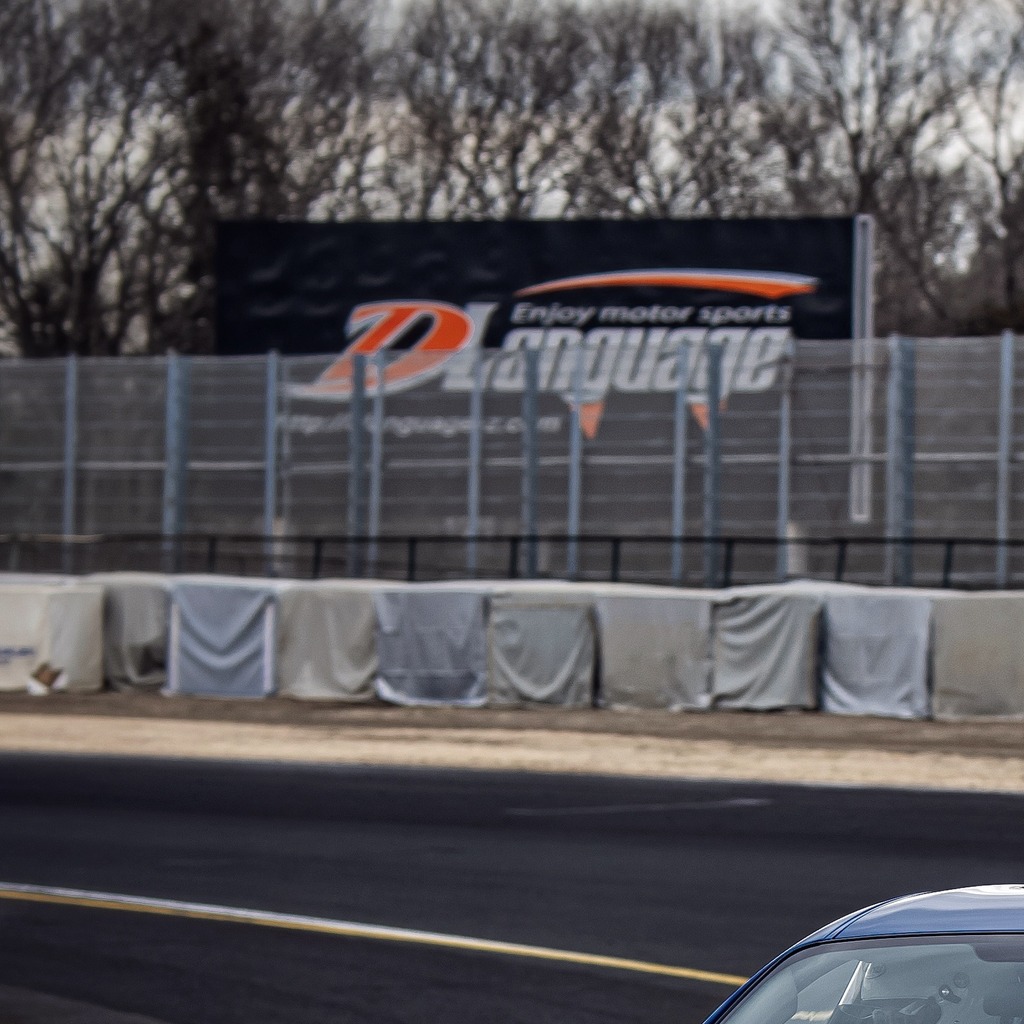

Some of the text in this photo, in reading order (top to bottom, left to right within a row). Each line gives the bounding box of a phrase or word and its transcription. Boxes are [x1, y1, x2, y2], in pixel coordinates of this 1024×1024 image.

[511, 303, 792, 325] Enjoy motor sports
